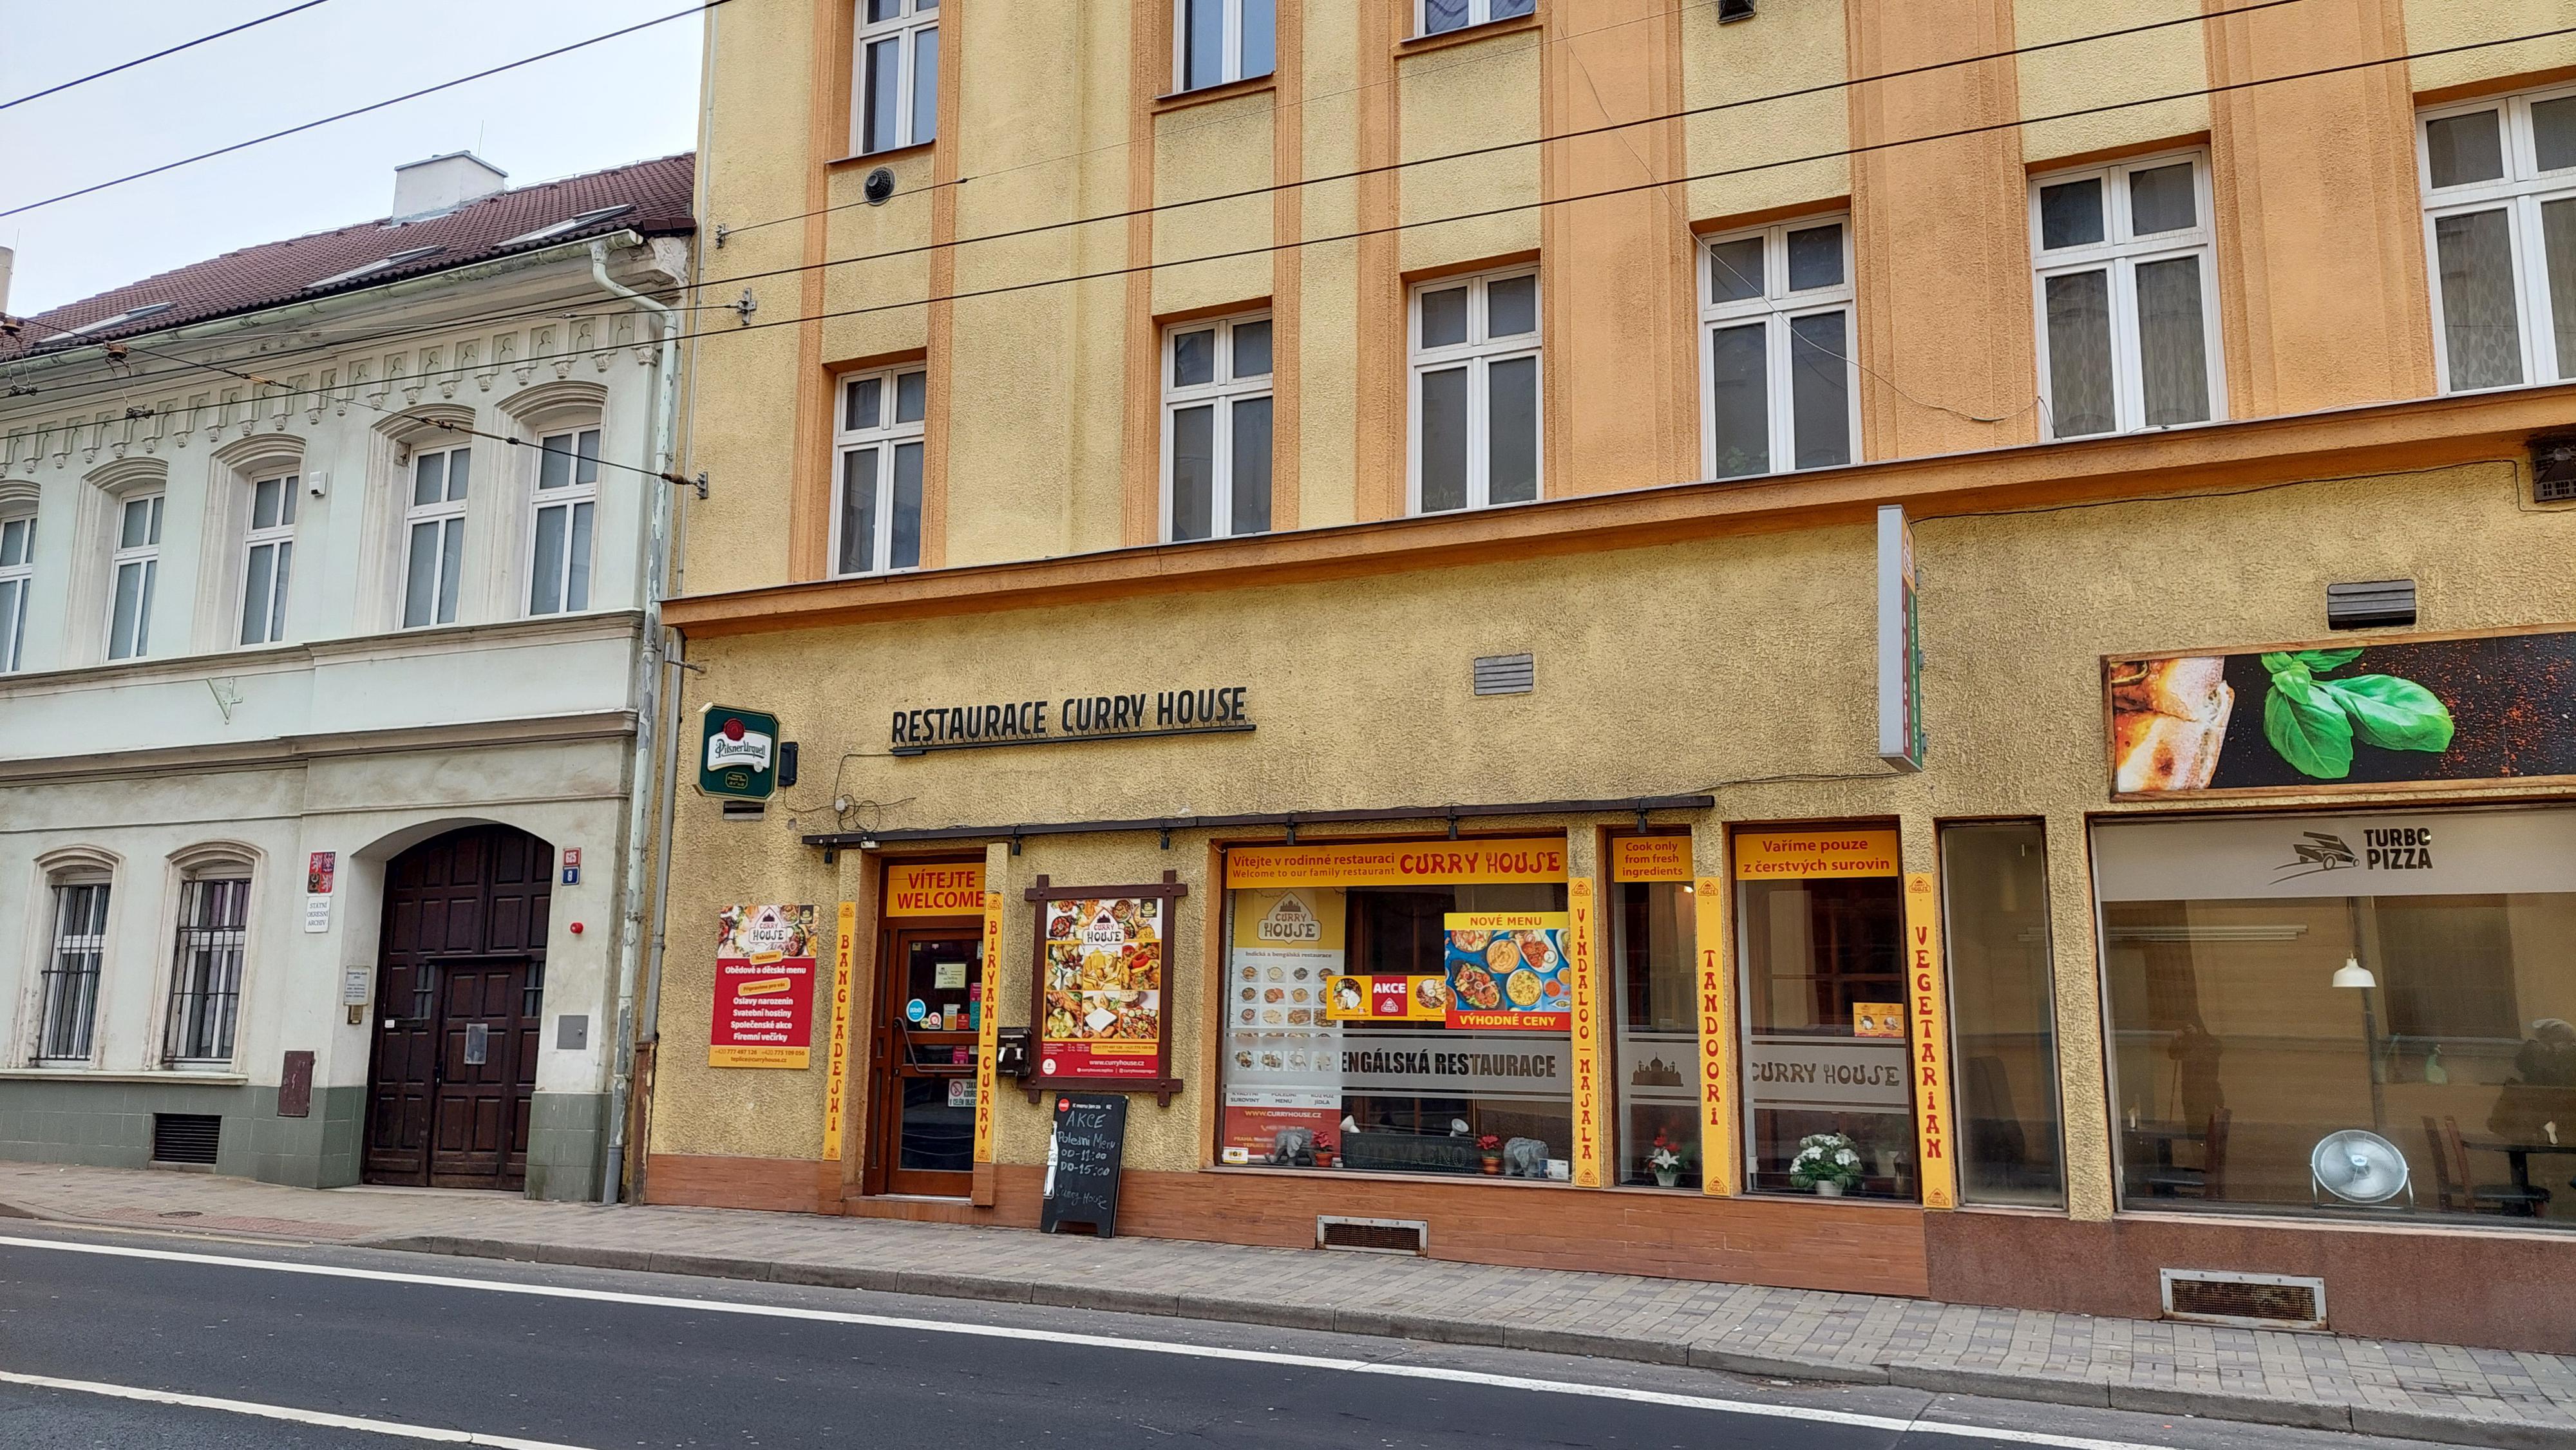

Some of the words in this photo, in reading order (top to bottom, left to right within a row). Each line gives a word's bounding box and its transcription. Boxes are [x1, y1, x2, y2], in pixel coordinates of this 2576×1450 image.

[891, 701, 1048, 742] RESTAURACE
[1061, 693, 1146, 732] CURRY
[1157, 686, 1247, 726] HOUSE
[715, 739, 743, 758] Pilsner
[743, 740, 766, 758] Urquell
[2363, 827, 2431, 847] TURBO
[1625, 842, 1653, 851] Cook
[1654, 841, 1678, 852] only
[1763, 840, 1815, 852] Vaříme
[1821, 840, 1868, 854] pouze
[1233, 856, 1271, 869] Vítejte
[1284, 854, 1331, 866] rodinné
[1334, 852, 1395, 865] restauraci
[1399, 852, 1479, 874] CURRY
[1486, 851, 1560, 874] HOUSE
[1625, 854, 1650, 863] from
[1653, 853, 1679, 863] fresh
[2367, 848, 2433, 870] PIZZA
[1233, 869, 1274, 878] Welcome
[1310, 868, 1340, 878] family
[1343, 867, 1395, 876] restaurant
[1623, 867, 1683, 878] ingredients
[1743, 863, 1751, 872] z
[1755, 859, 1827, 874] čerstvých
[1831, 857, 1889, 871] surovin
[567, 871, 573, 881] 8
[908, 869, 975, 889] VÍTEJTE
[897, 891, 985, 909] WELCOME
[1274, 913, 1307, 922] CURRY
[1470, 914, 1503, 926] NOVÉ
[1507, 916, 1542, 925] MENU
[753, 930, 784, 941] HOUSE
[1264, 922, 1315, 937] HOUSE
[1087, 931, 1121, 943] HOUSE
[725, 966, 755, 974] Obědové
[762, 965, 785, 974] dětské
[1373, 983, 1406, 993] AKCE
[733, 997, 757, 1006] Oslavy
[758, 997, 793, 1005] narozenin
[733, 1008, 764, 1017] Svatební
[764, 1009, 791, 1018] hostiny
[1459, 1012, 1520, 1025] VÝHODNÉ
[1523, 1016, 1557, 1026] CENY
[730, 1020, 774, 1030] Společenské
[775, 1021, 792, 1029] akce
[733, 1032, 761, 1040] Firemní
[761, 1032, 788, 1042] večírky
[1435, 1052, 1557, 1078] RESTAURACE
[1752, 1061, 1816, 1083] CURRY
[1823, 1064, 1899, 1086] HOUSE
[980, 1055, 992, 1140] CURRY
[1579, 1058, 1592, 1160] MASALA
[1066, 1111, 1106, 1128] AKCE
